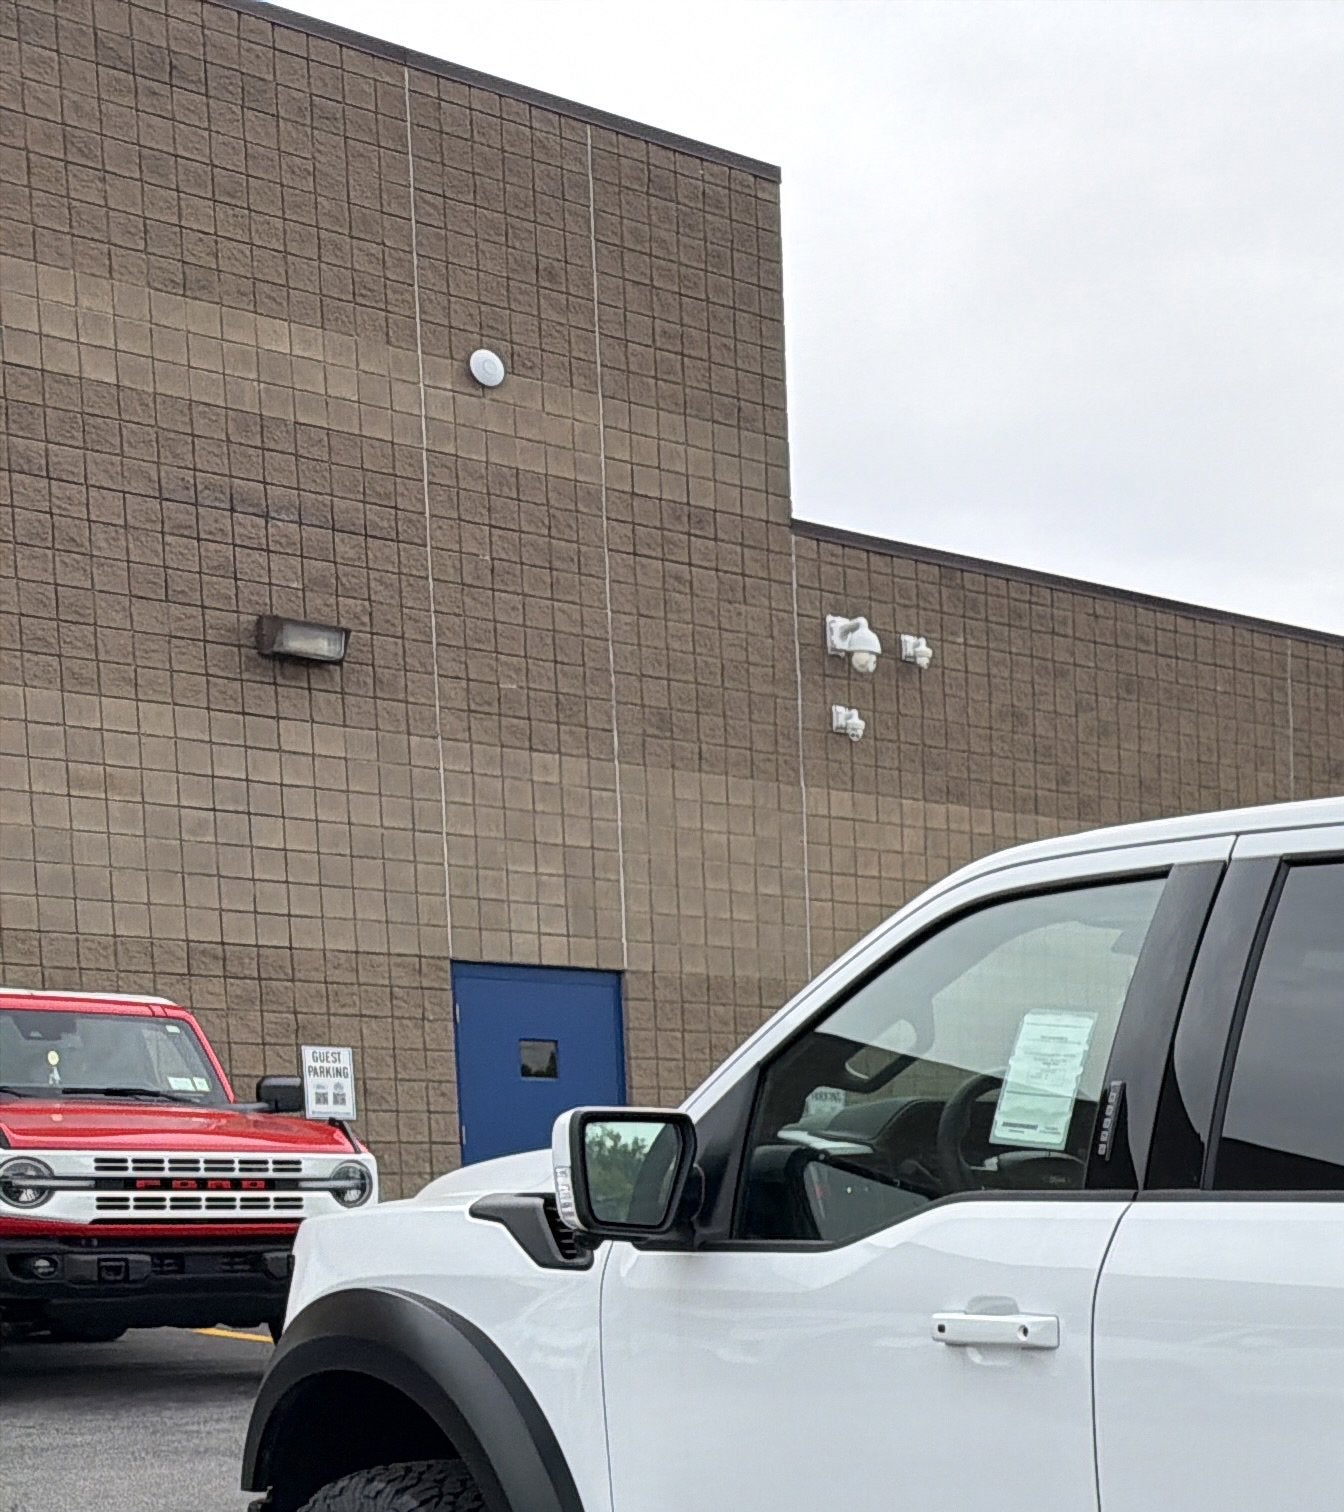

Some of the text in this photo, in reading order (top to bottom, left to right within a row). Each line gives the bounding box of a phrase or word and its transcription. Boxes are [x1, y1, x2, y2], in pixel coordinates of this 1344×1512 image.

[311, 1050, 342, 1065] GUEST
[307, 1065, 350, 1079] PARKING
[135, 1179, 266, 1189] FORD
